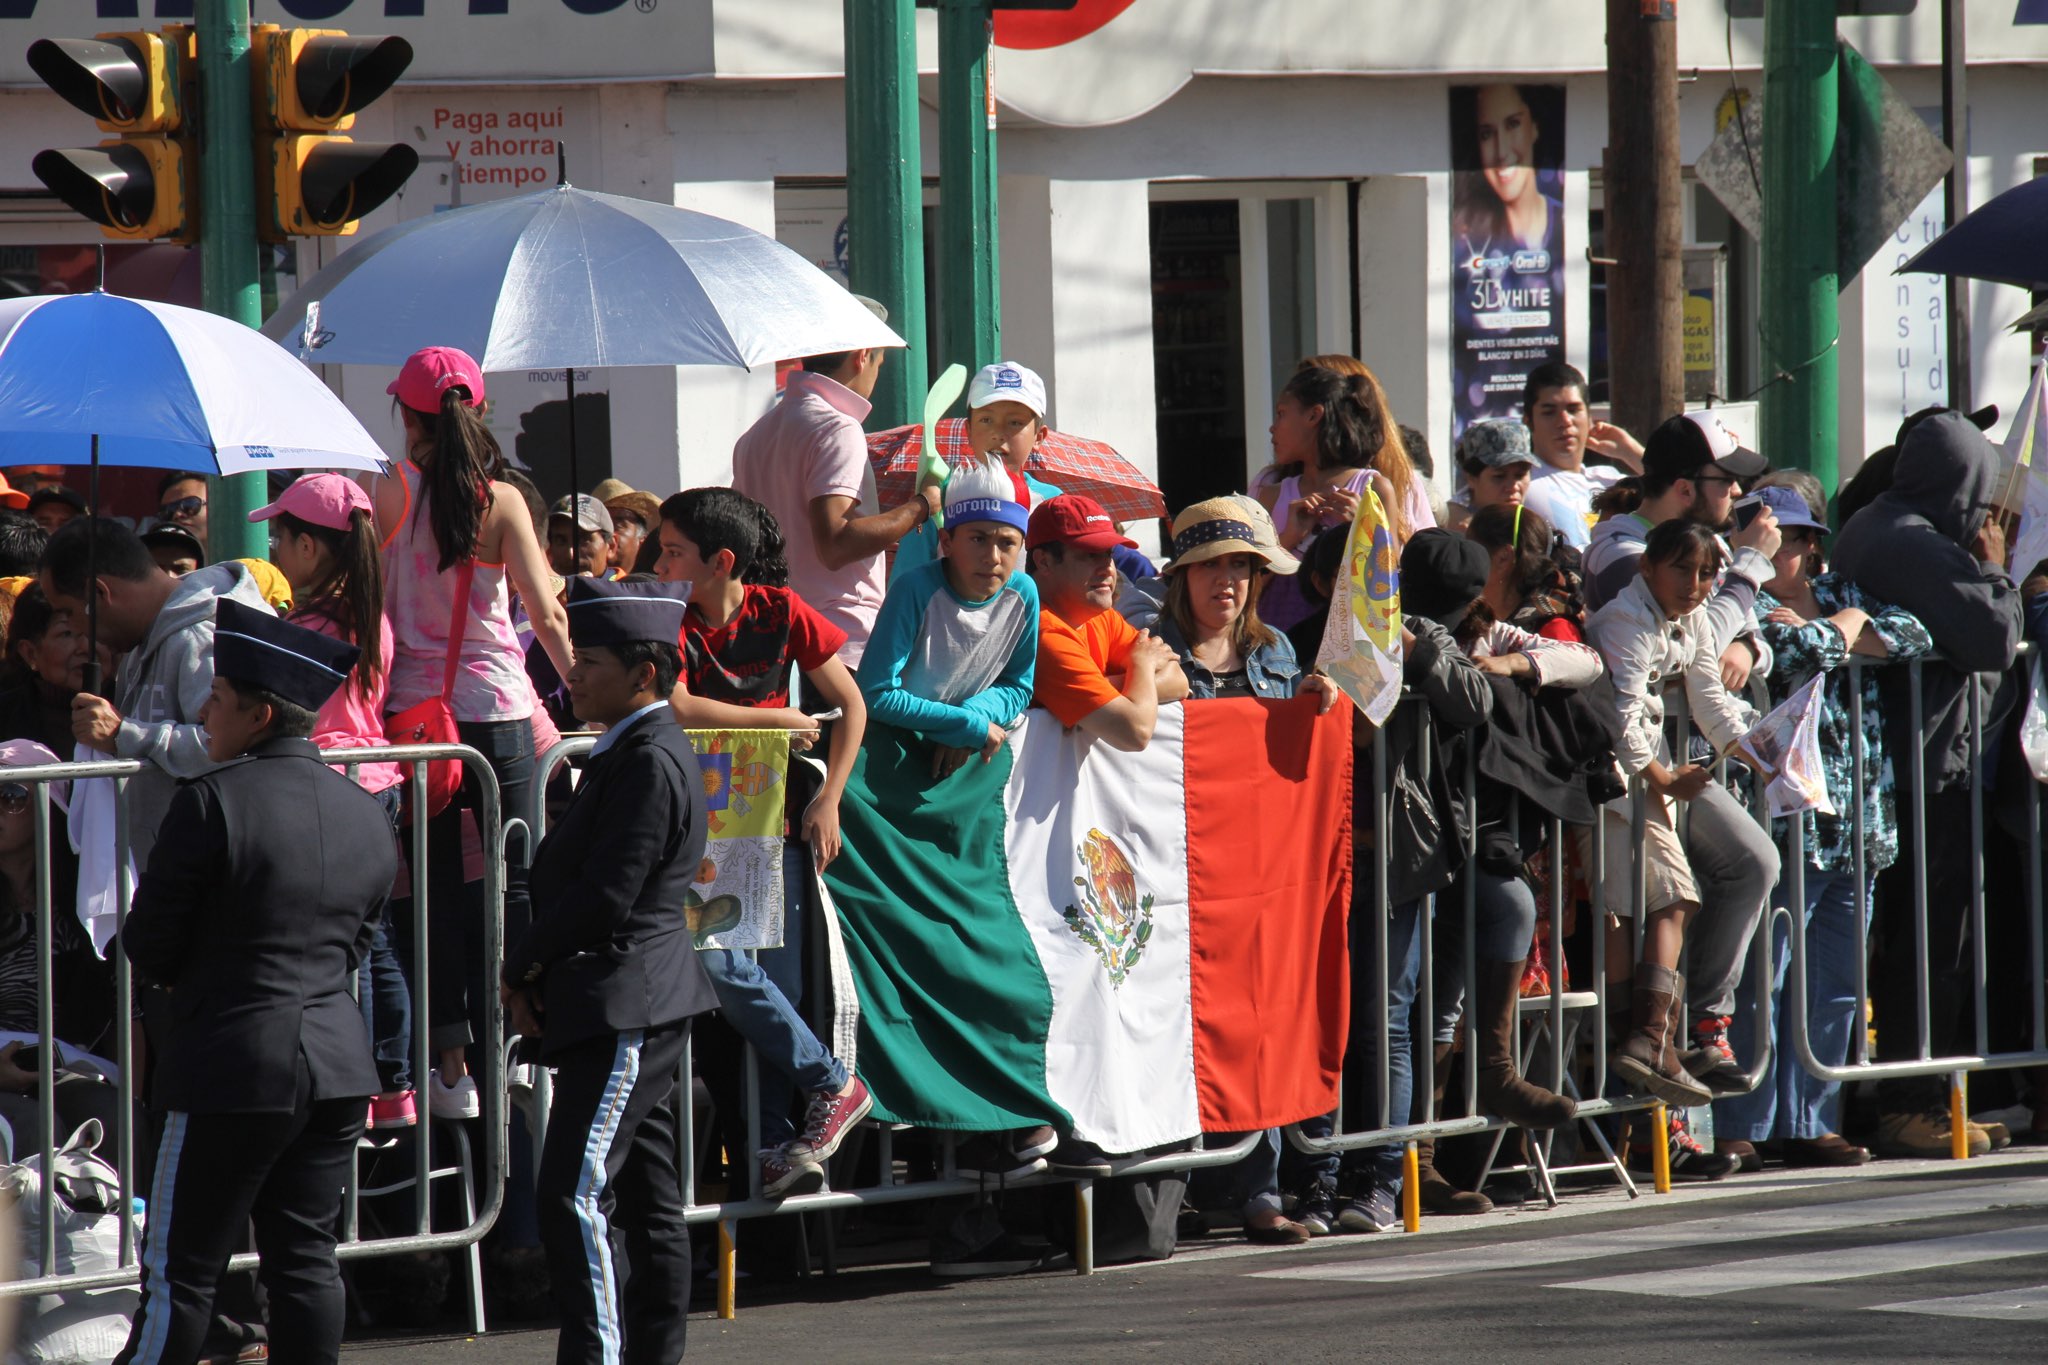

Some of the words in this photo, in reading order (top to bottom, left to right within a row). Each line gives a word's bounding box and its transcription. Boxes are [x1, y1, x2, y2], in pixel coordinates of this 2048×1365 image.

[434, 108, 498, 134] Paga
[507, 106, 563, 133] aquí
[446, 140, 460, 160] y
[470, 134, 555, 156] ahorra
[458, 163, 547, 188] tiempo
[528, 370, 593, 383] movisar
[946, 499, 1001, 519] Corona
[769, 875, 779, 935] FRANCISCO
